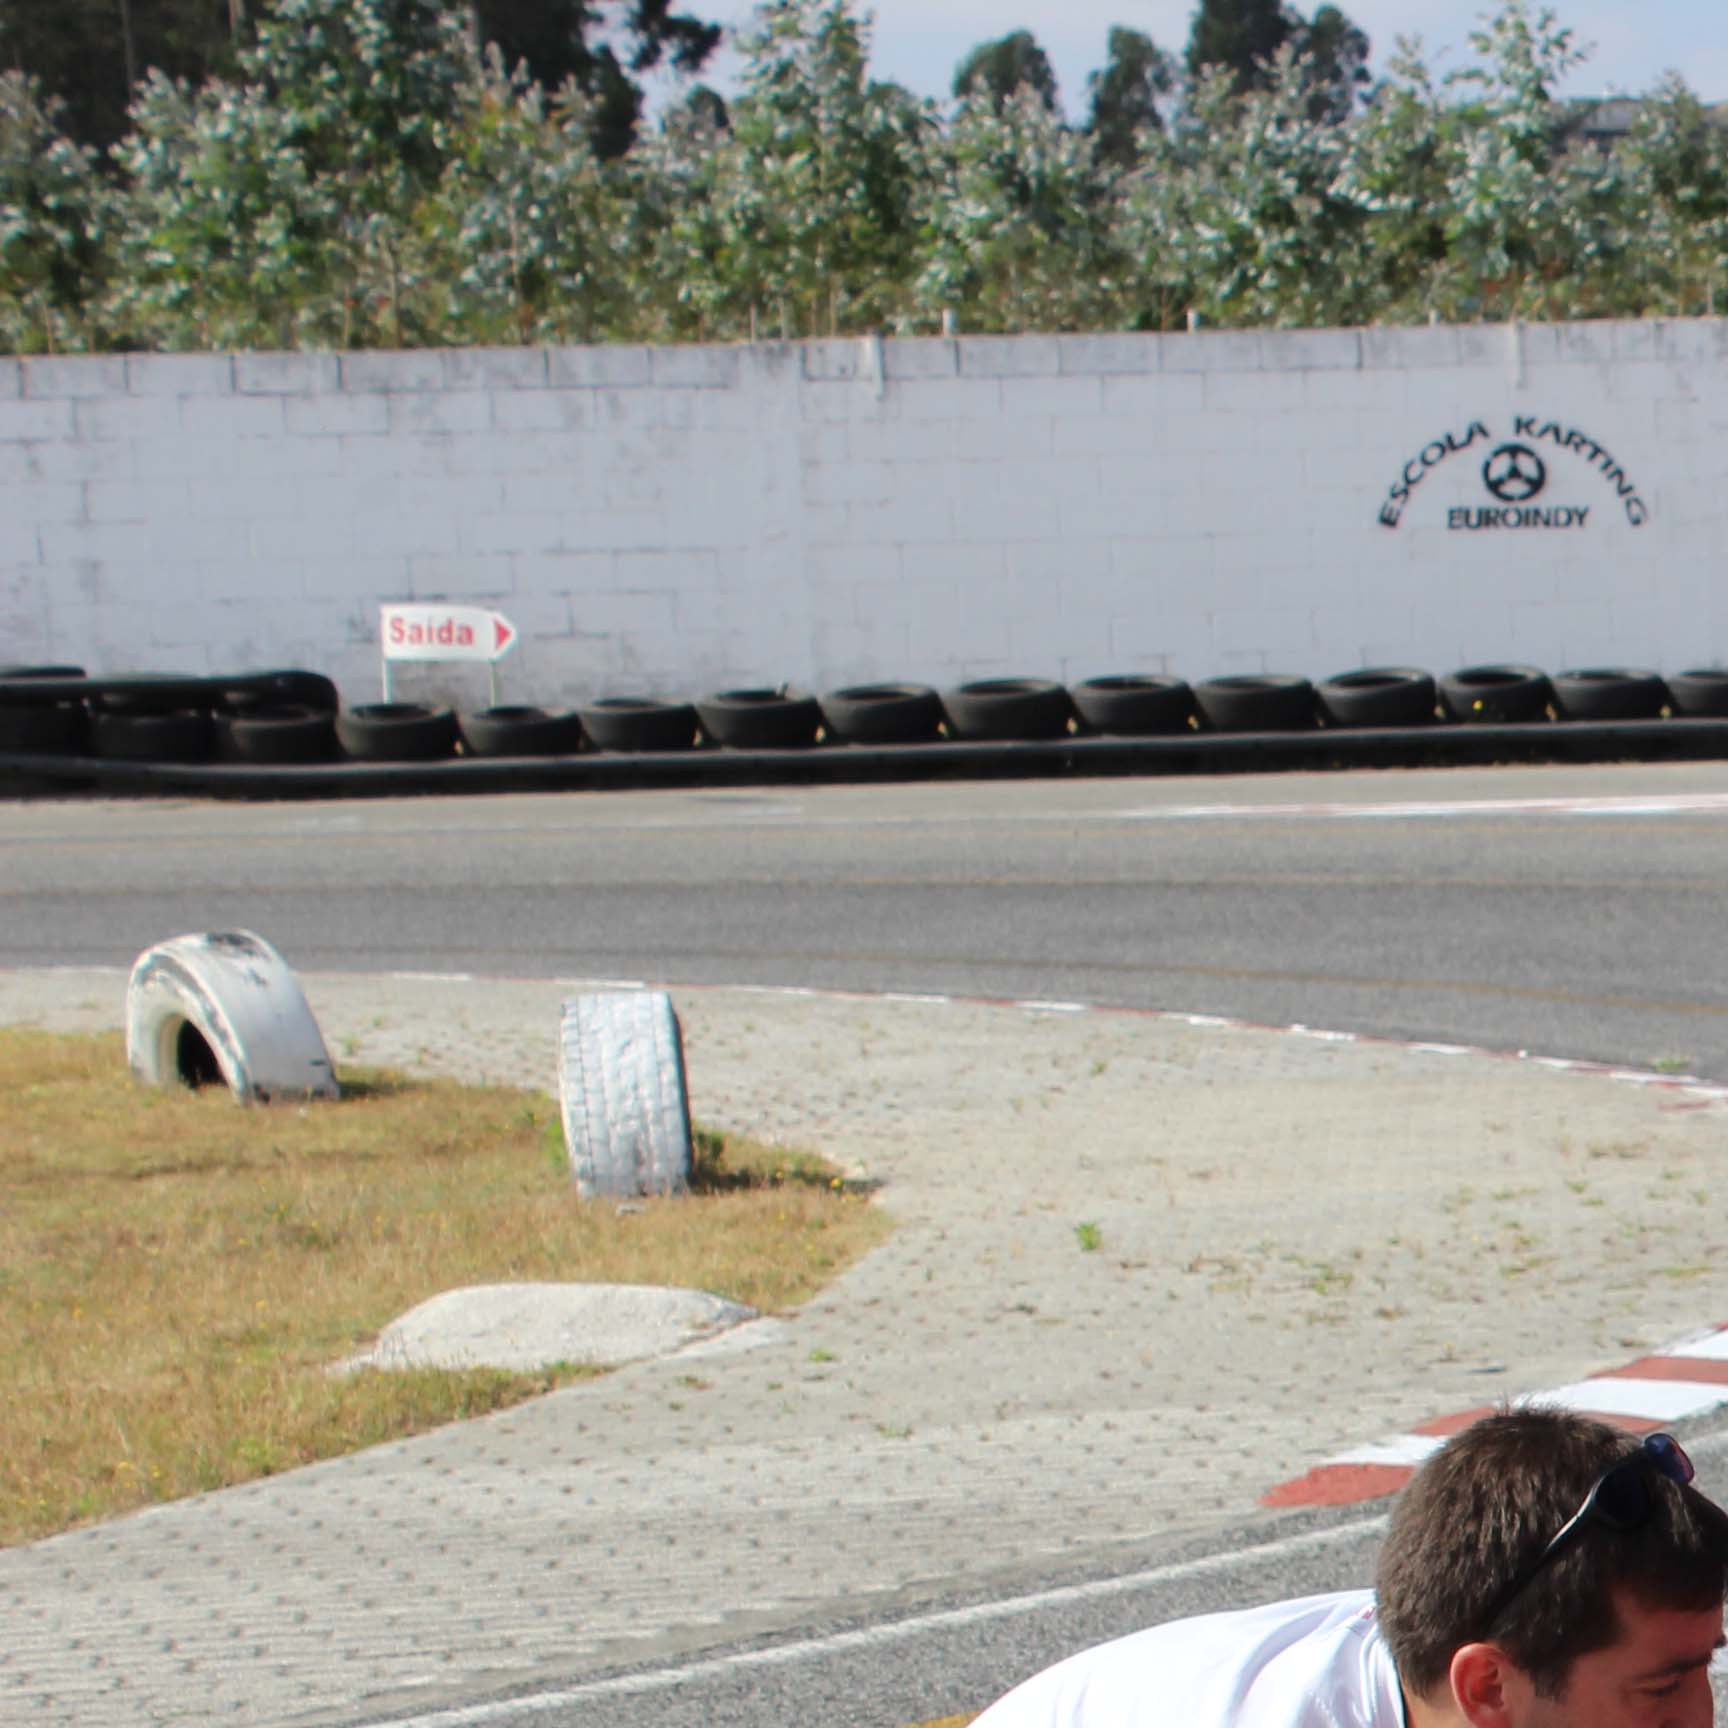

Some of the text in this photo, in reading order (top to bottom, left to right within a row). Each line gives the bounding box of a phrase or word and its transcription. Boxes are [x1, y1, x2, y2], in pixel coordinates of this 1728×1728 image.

[1376, 415, 1650, 528] ESCOLA KARTING
[1446, 505, 1590, 530] EUROINDY
